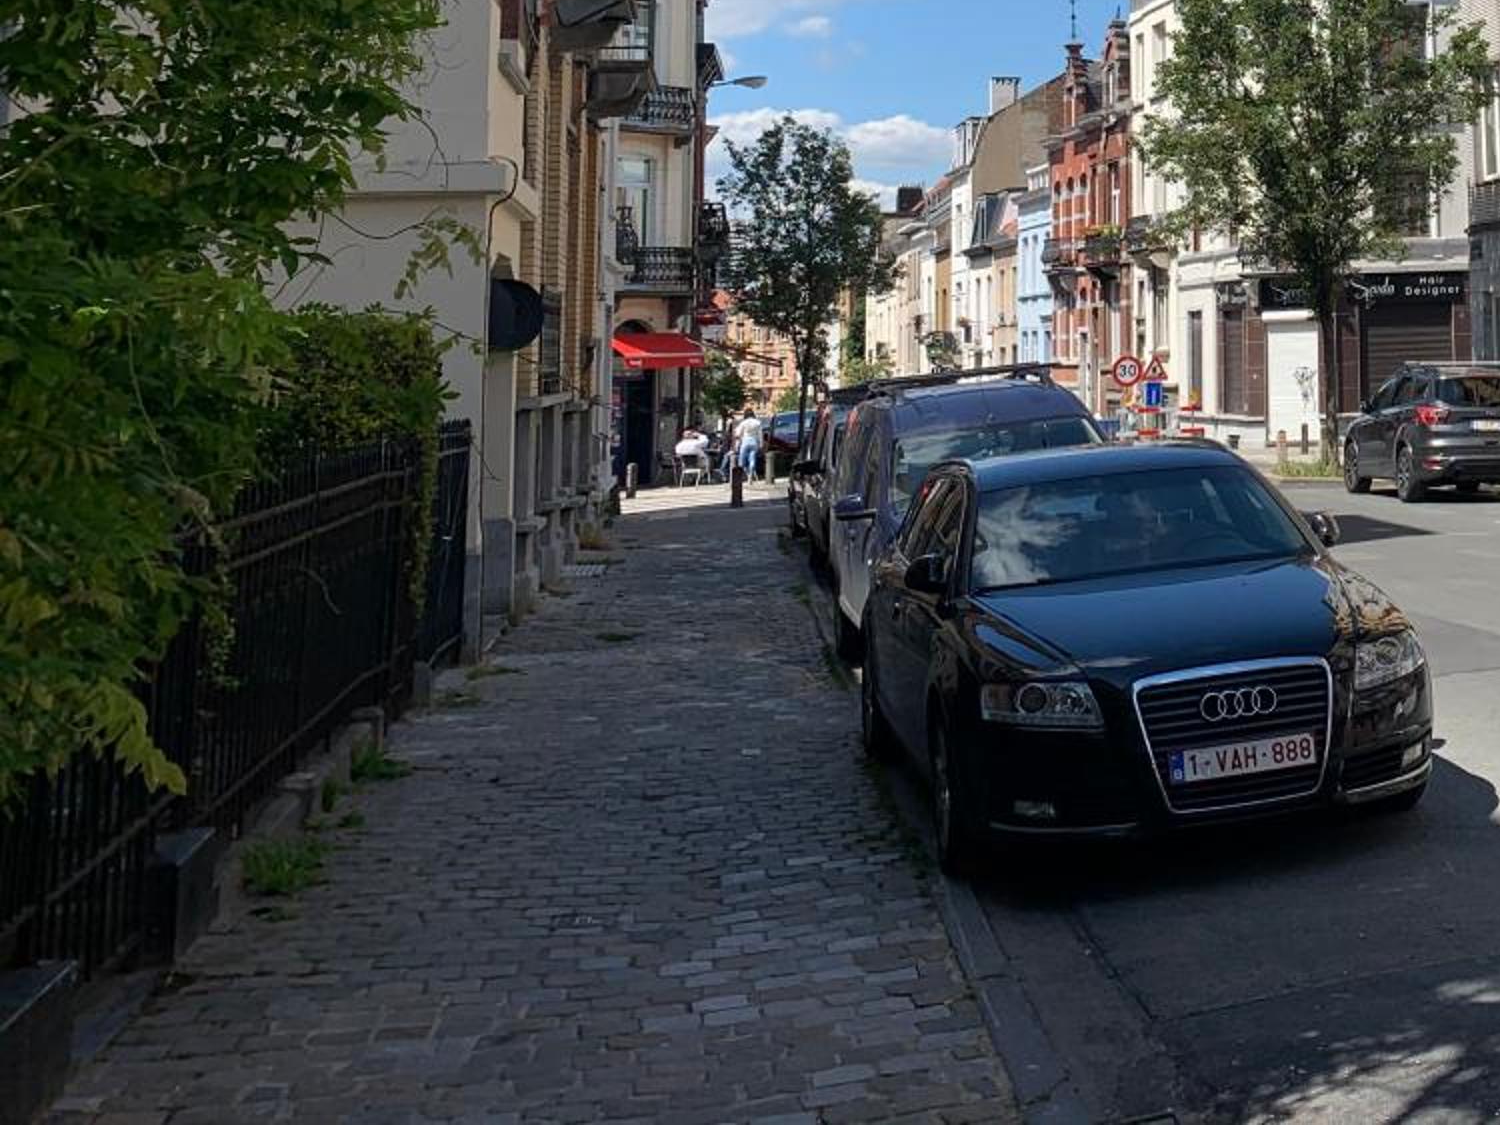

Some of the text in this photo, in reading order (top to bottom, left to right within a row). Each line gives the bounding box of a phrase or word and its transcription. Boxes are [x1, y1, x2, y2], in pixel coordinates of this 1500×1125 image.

[1419, 276, 1444, 285] Hair
[1405, 285, 1460, 296] Designer
[1119, 364, 1137, 378] 30
[1189, 737, 1312, 776] 1-VAH-888
